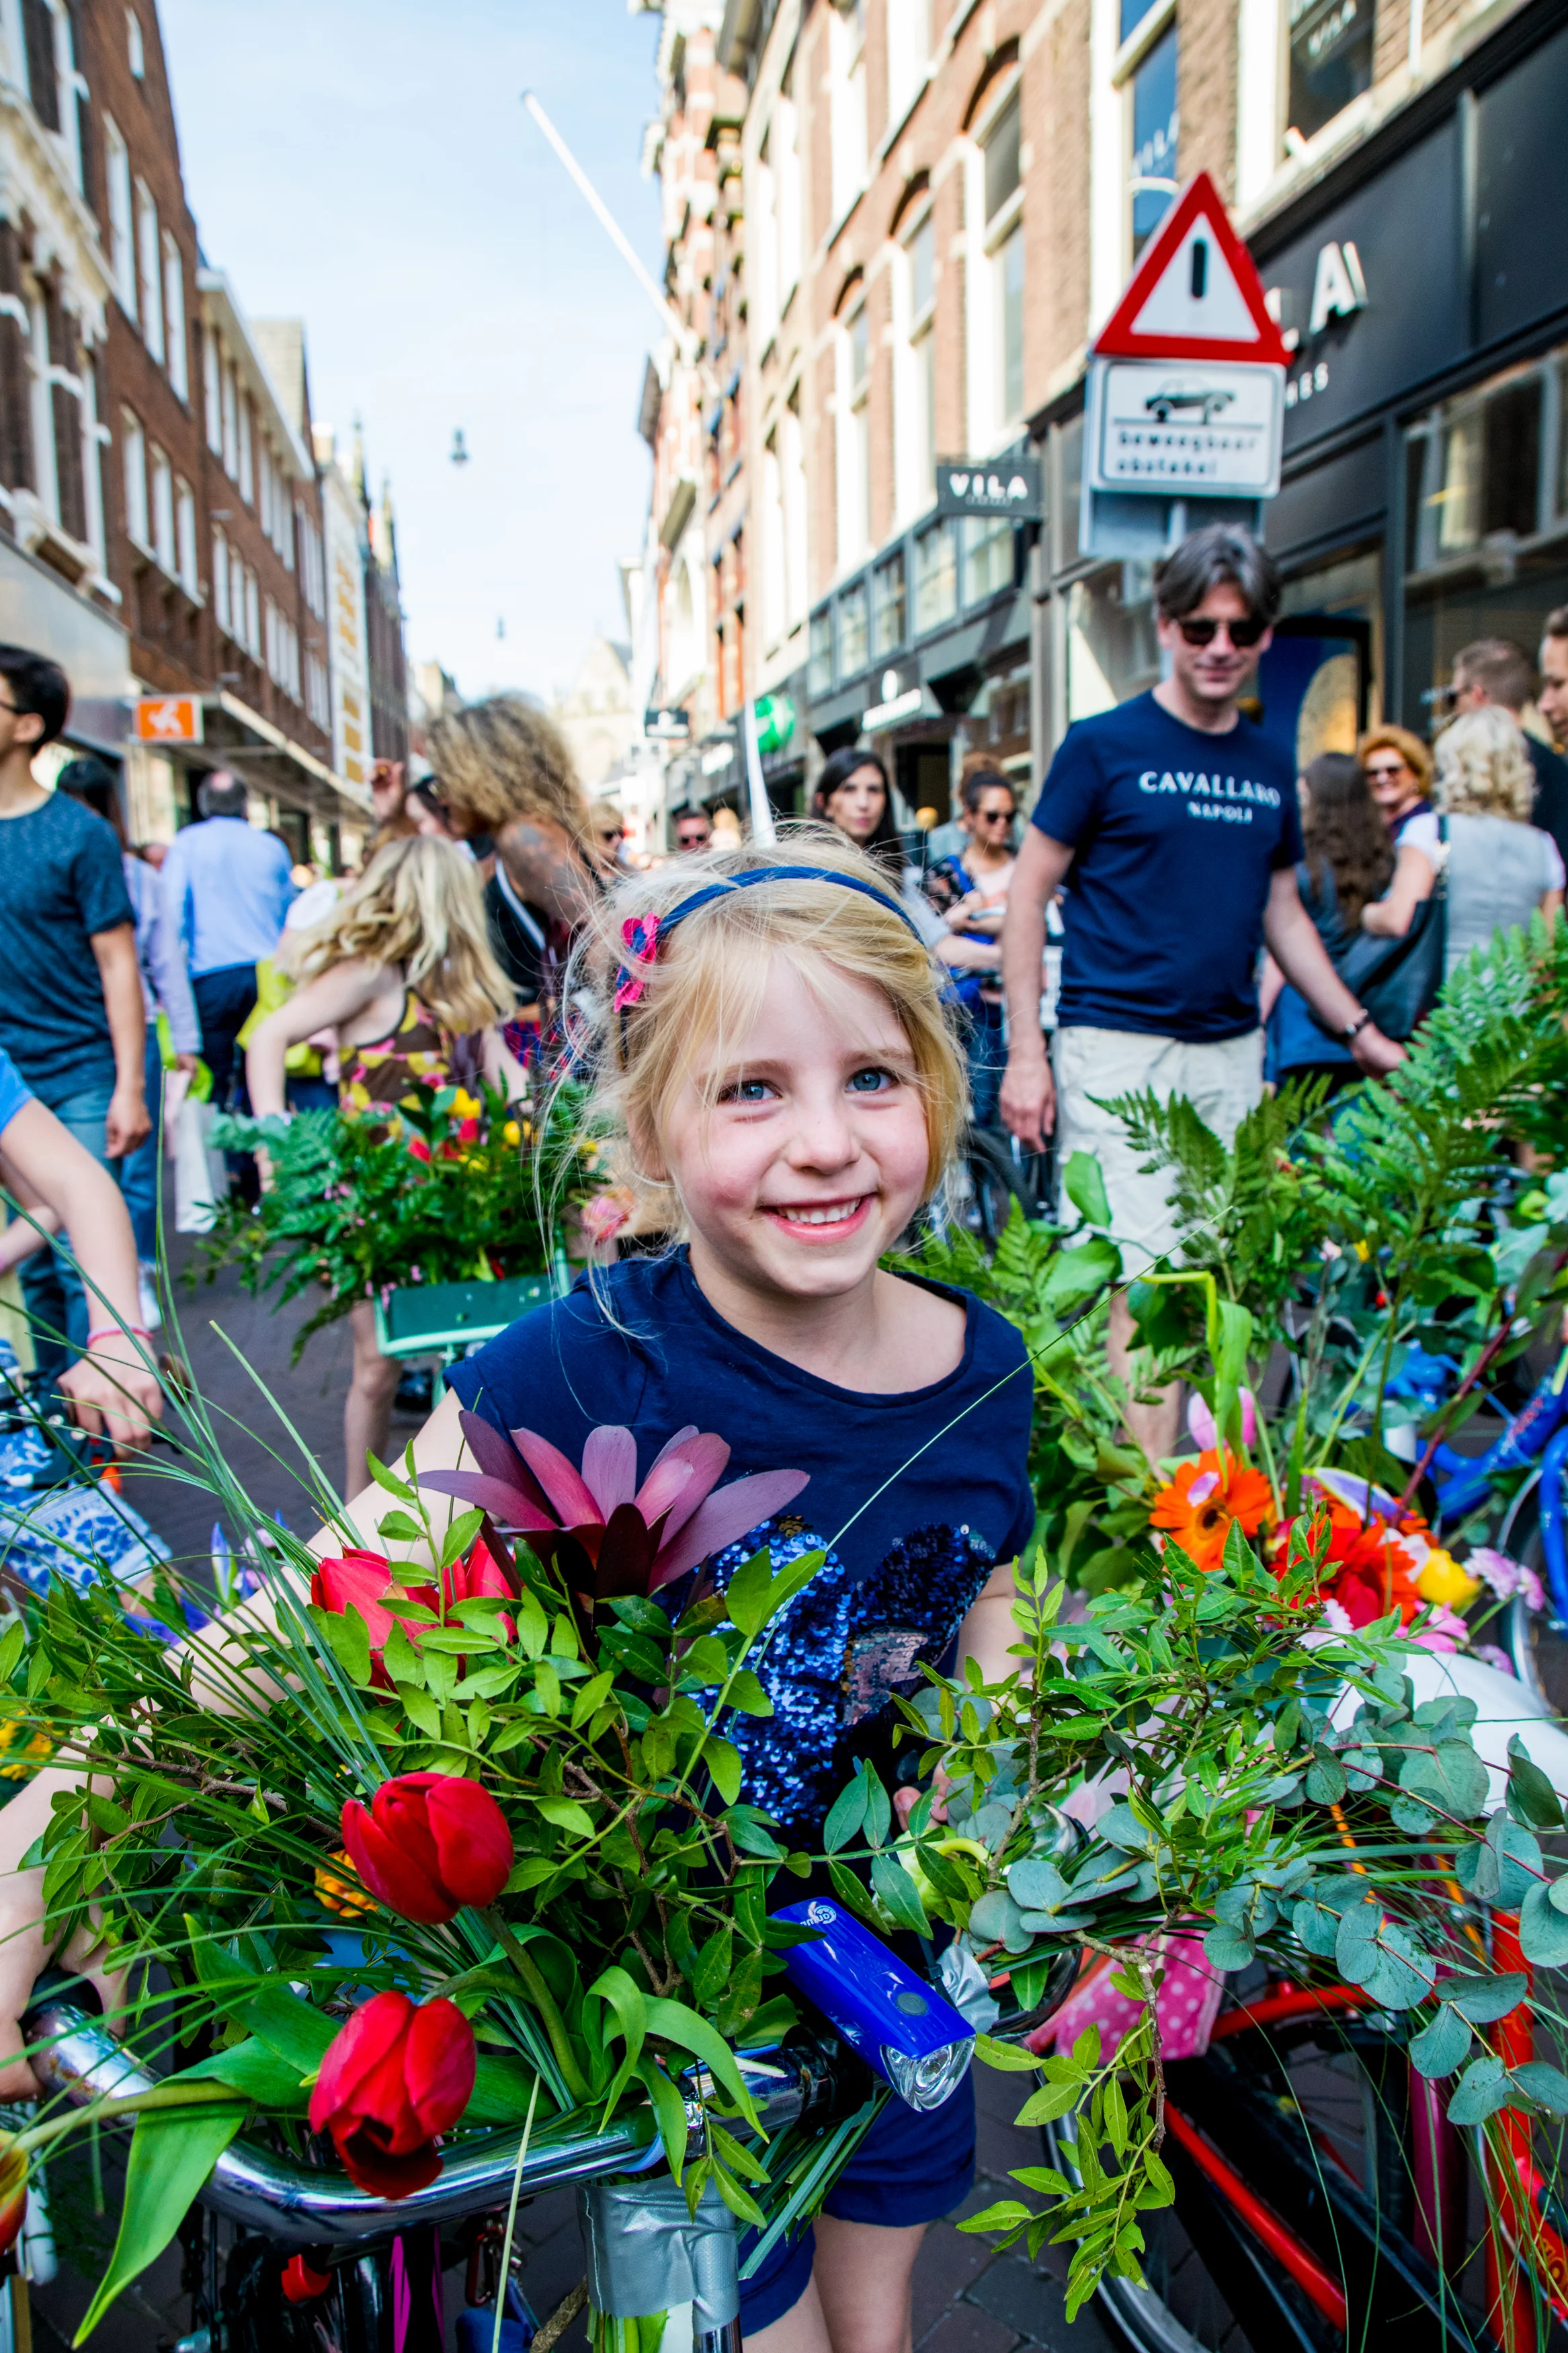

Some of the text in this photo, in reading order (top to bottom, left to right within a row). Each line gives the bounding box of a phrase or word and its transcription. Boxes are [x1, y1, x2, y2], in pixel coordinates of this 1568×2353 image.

[949, 473, 1028, 500] VILA
[1138, 770, 1282, 809] CAVALLARO
[1187, 801, 1253, 825] NAPOLI
